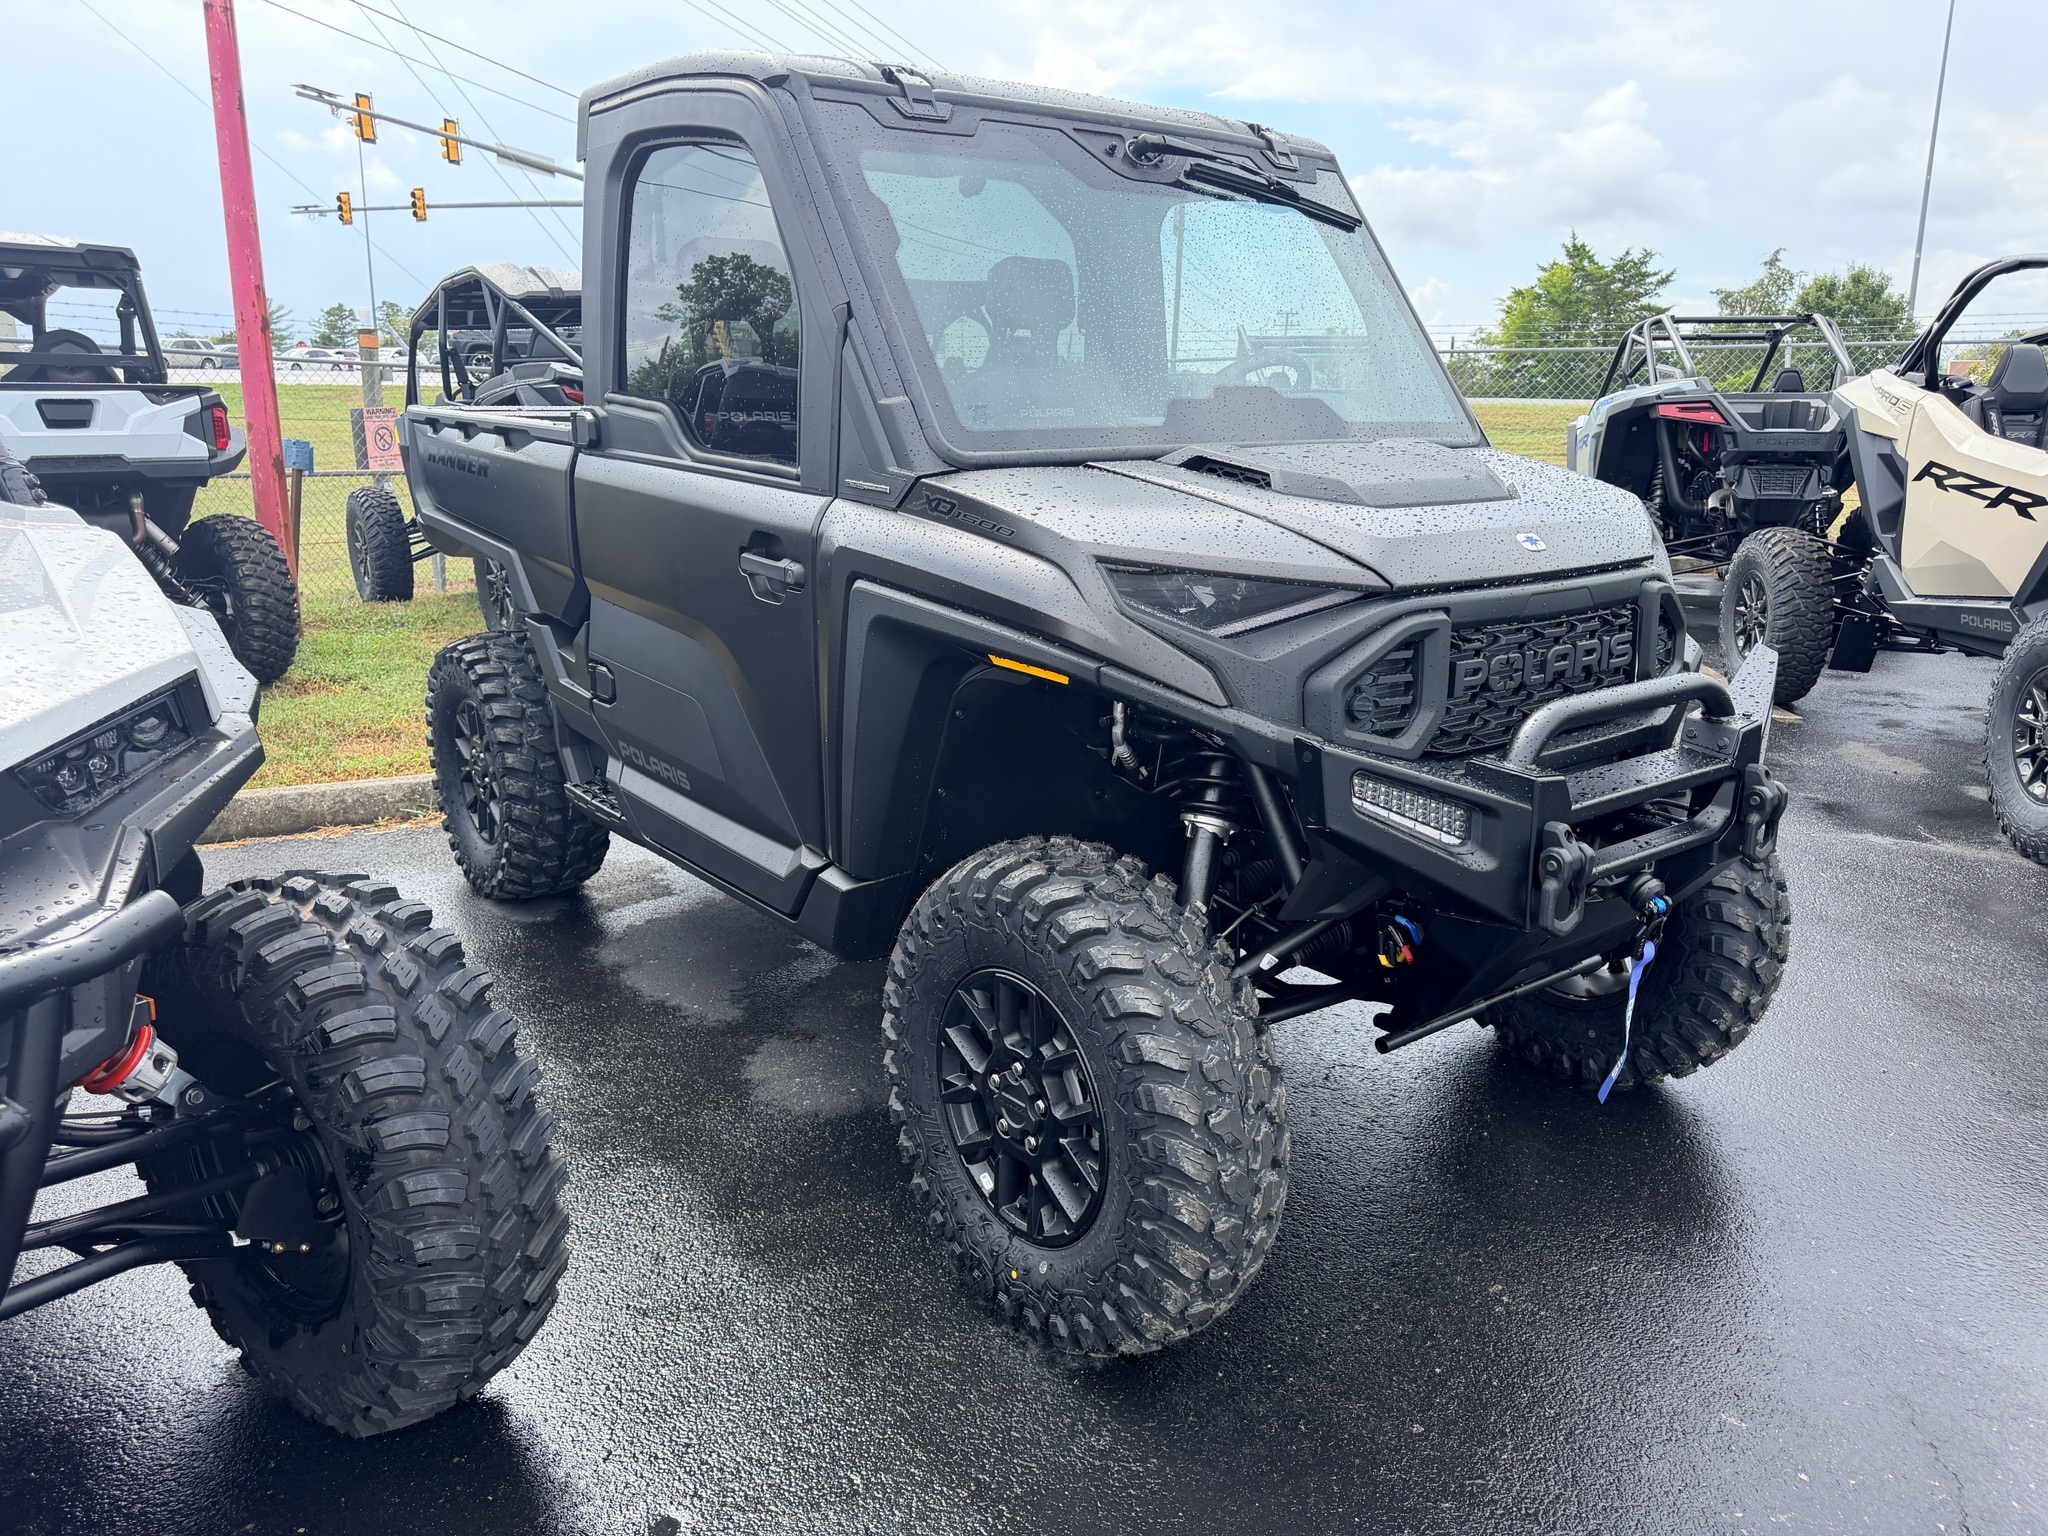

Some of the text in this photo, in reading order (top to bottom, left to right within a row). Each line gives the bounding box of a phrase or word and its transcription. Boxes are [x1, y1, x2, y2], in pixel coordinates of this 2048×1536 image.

[717, 411, 792, 422] POLARIS
[1020, 408, 1075, 418] POLARIS
[428, 446, 491, 479] RANGER
[1756, 438, 1821, 446] POLARIS
[1911, 460, 2048, 522] RZR
[907, 490, 1016, 539] XD 1500
[1960, 614, 2013, 633] POLARIS
[1455, 631, 1633, 698] POLARIS
[617, 740, 691, 791] POLARIS
[922, 1108, 1036, 1275] CROSS TRAIL
